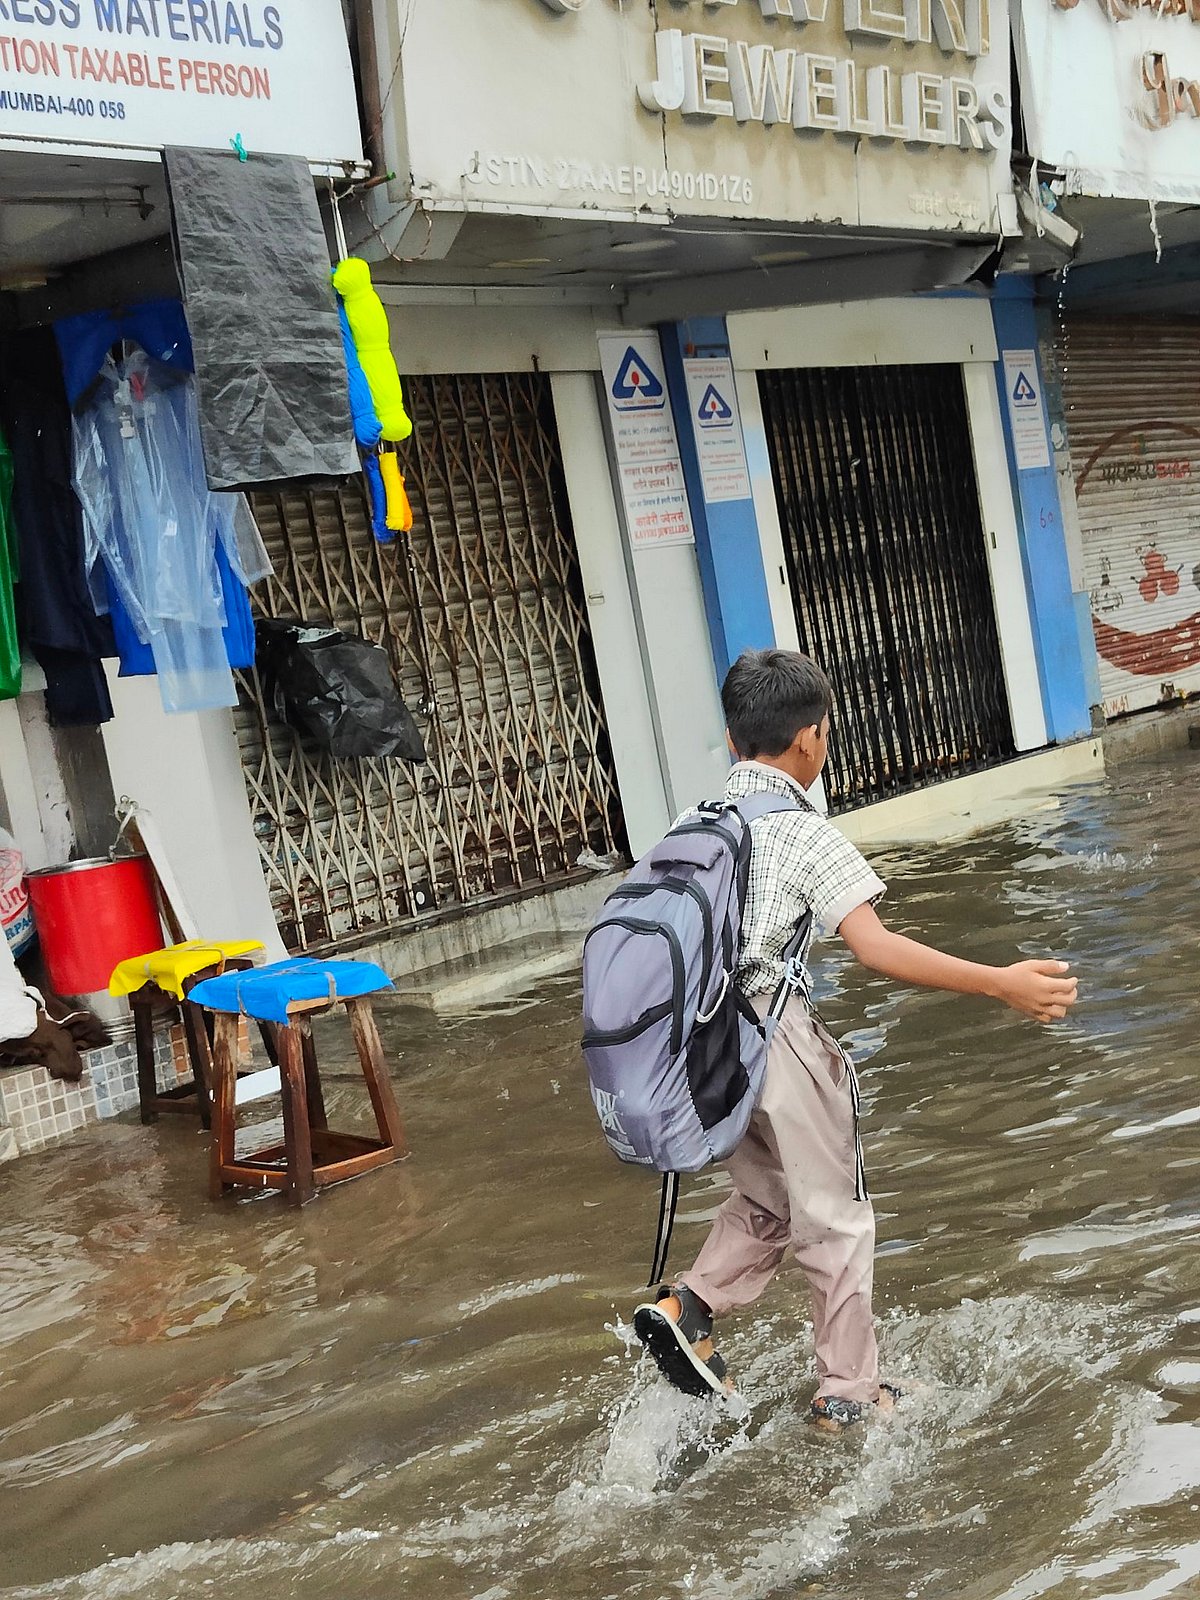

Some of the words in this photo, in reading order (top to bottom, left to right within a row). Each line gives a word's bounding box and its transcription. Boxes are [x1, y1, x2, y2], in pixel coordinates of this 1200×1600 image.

[93, 0, 283, 50] MATERIALS
[62, 44, 175, 90] TAXABLE
[178, 58, 271, 100] PERSON
[640, 28, 1012, 150] JEWELLERS
[99, 100, 126, 120] 058
